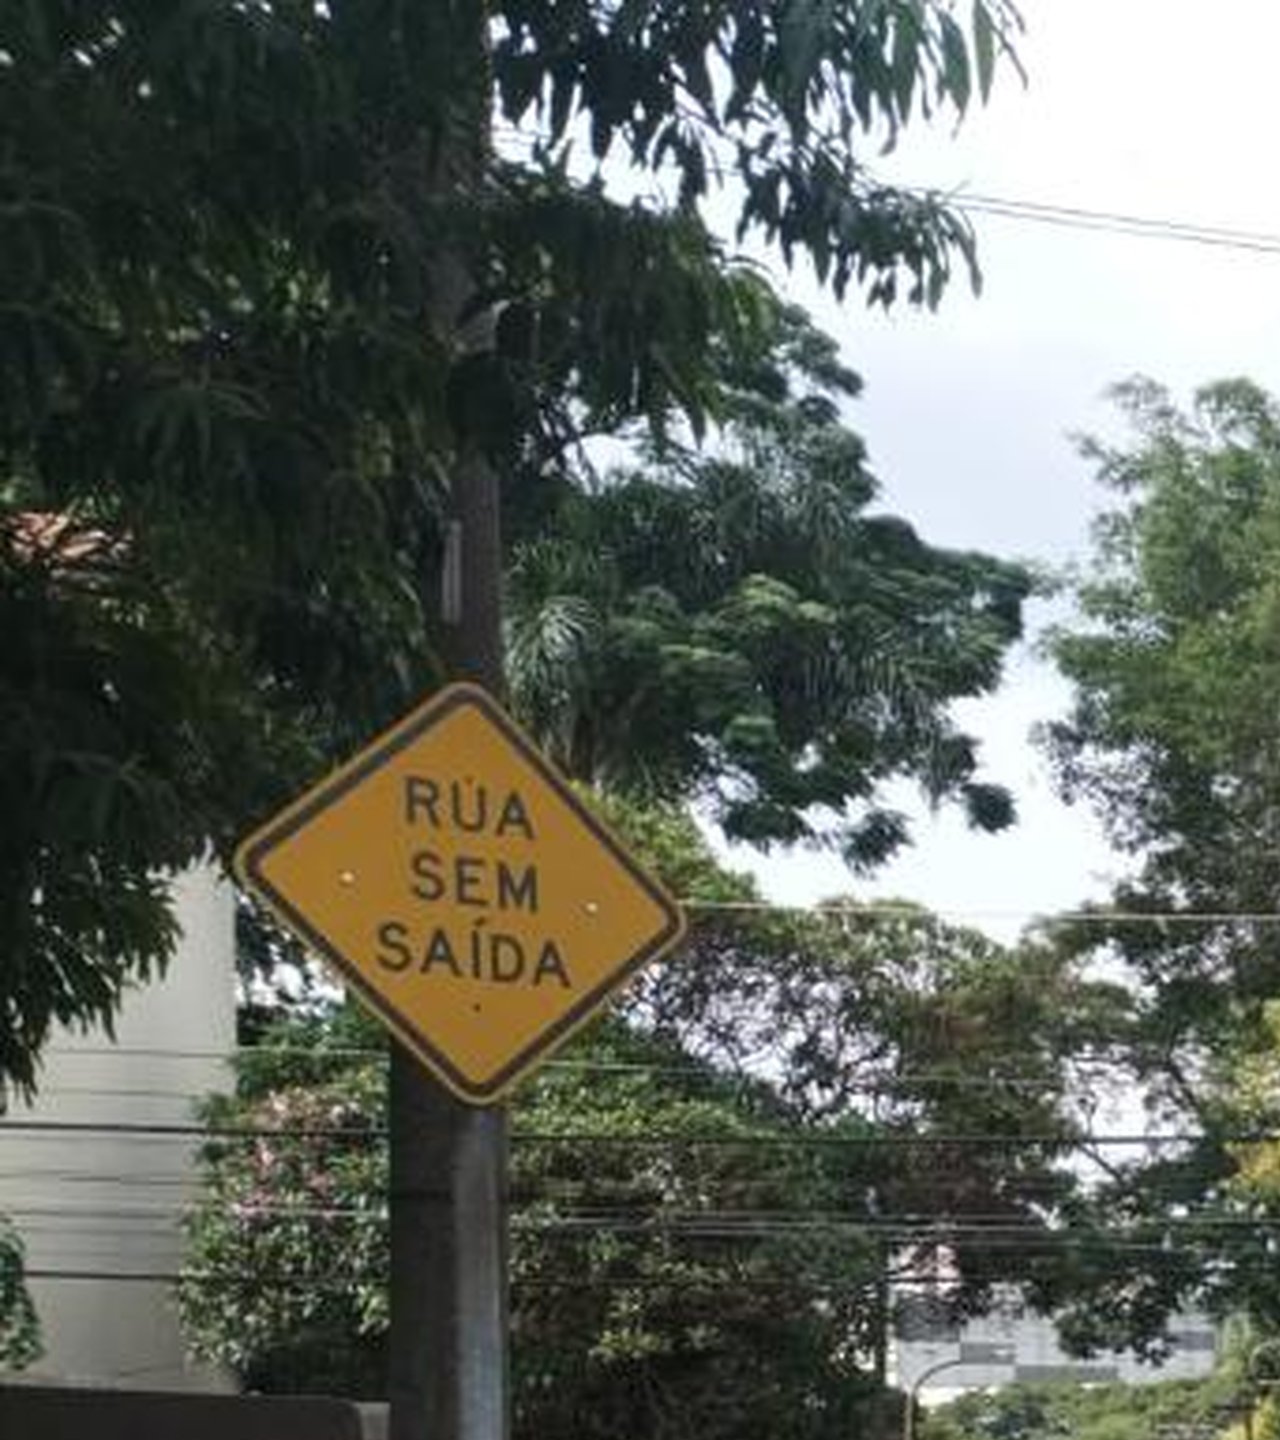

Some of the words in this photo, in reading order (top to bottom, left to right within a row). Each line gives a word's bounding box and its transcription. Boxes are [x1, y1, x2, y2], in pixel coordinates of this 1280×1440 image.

[404, 776, 536, 841] RUA
[412, 850, 539, 912] SEM
[376, 917, 572, 989] SAÍDA
